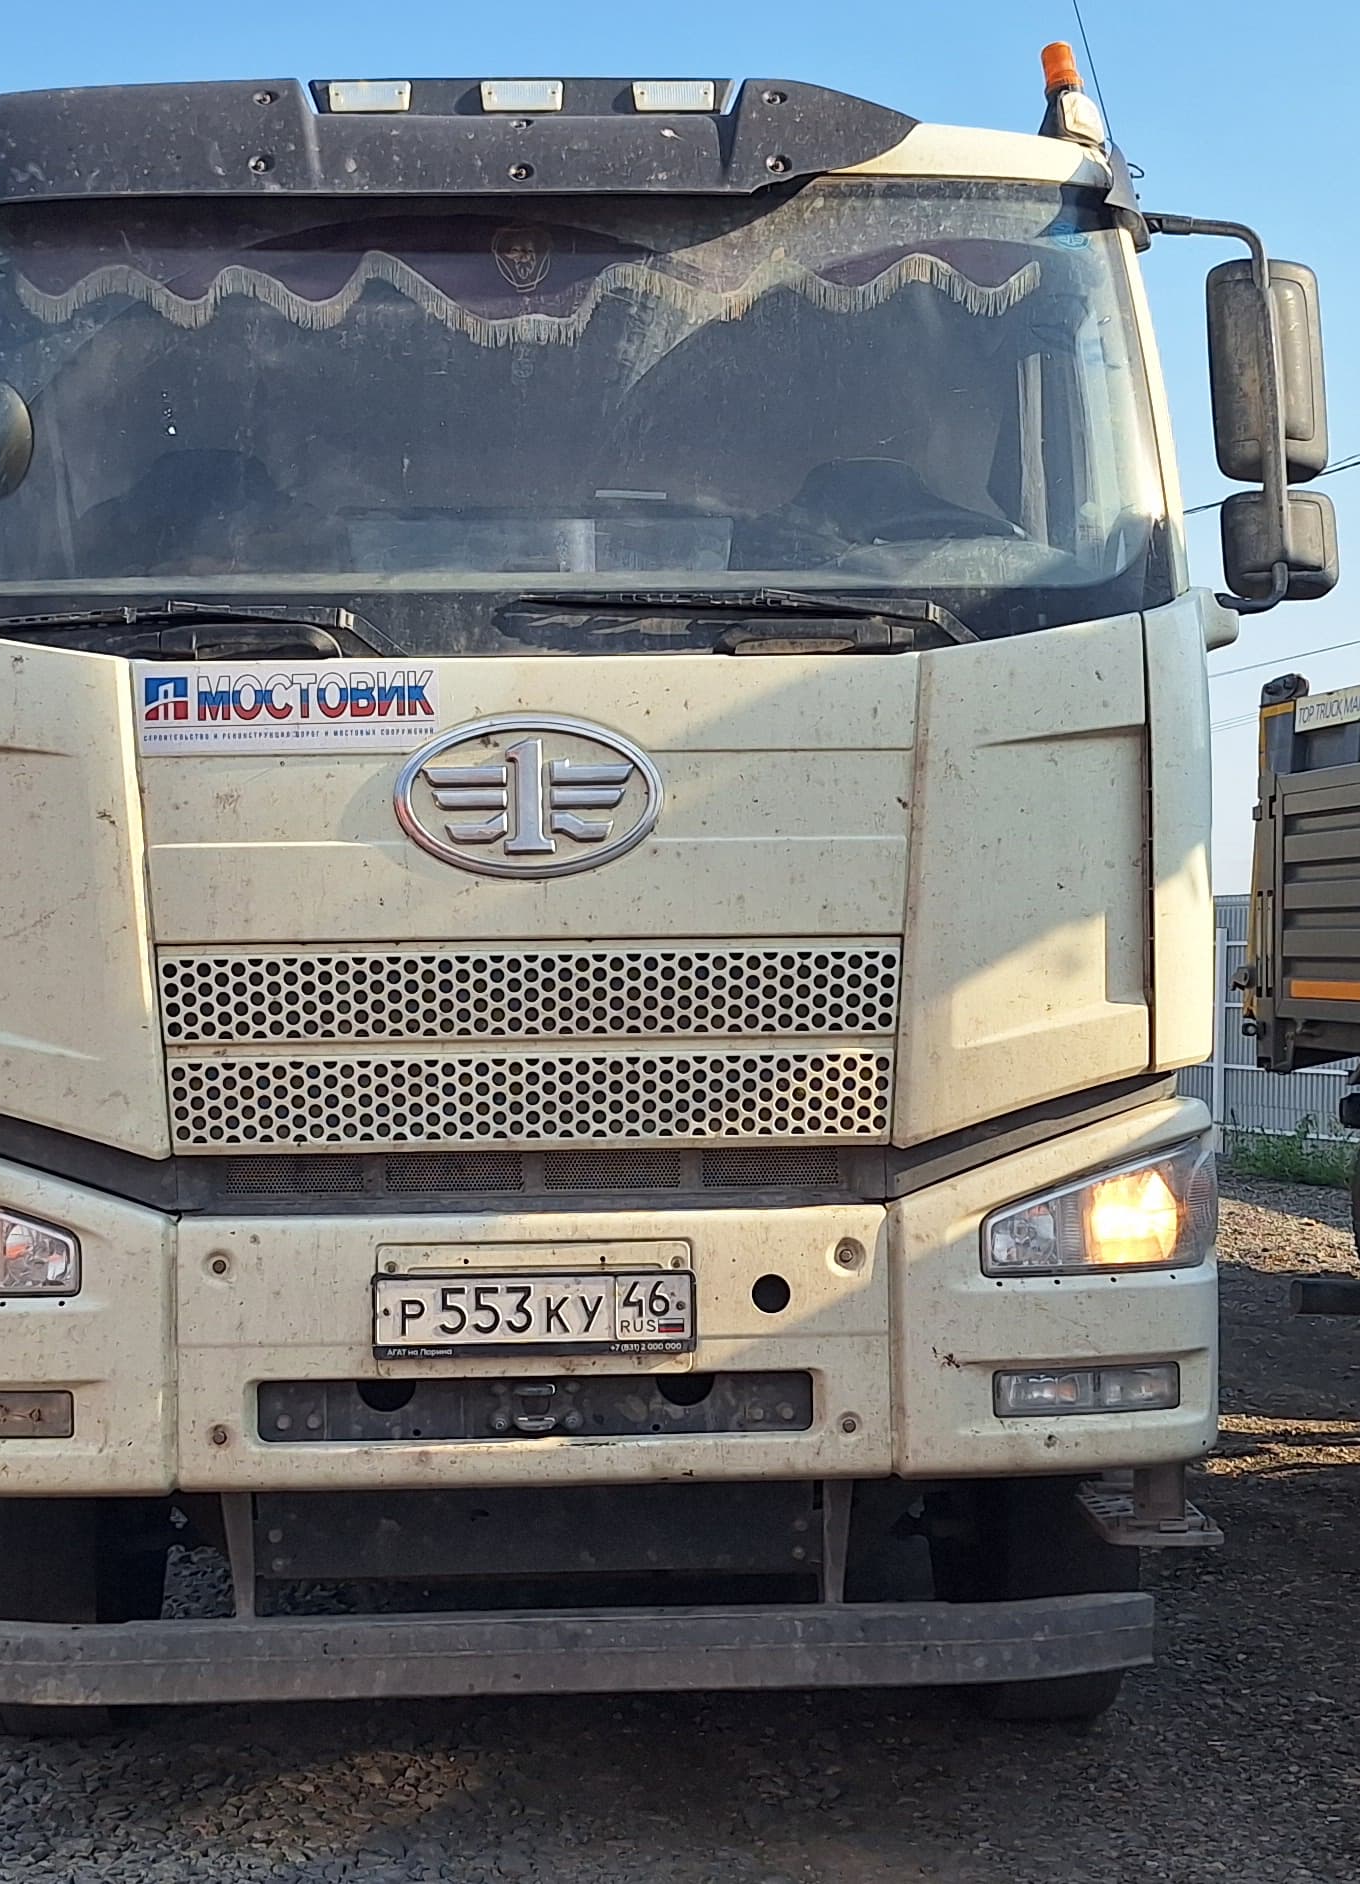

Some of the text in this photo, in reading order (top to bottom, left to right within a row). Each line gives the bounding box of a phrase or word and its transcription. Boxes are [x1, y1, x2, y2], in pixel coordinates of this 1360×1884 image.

[197, 670, 435, 721] МОСТОВИК
[1298, 705, 1314, 724] TOP
[1316, 698, 1343, 720] TRUCK
[622, 1280, 671, 1318] 46
[619, 1318, 656, 1334] RUS
[609, 1343, 620, 1352] +7
[640, 1343, 646, 1351] 2
[647, 1342, 663, 1351] 000
[664, 1342, 682, 1350] 000
